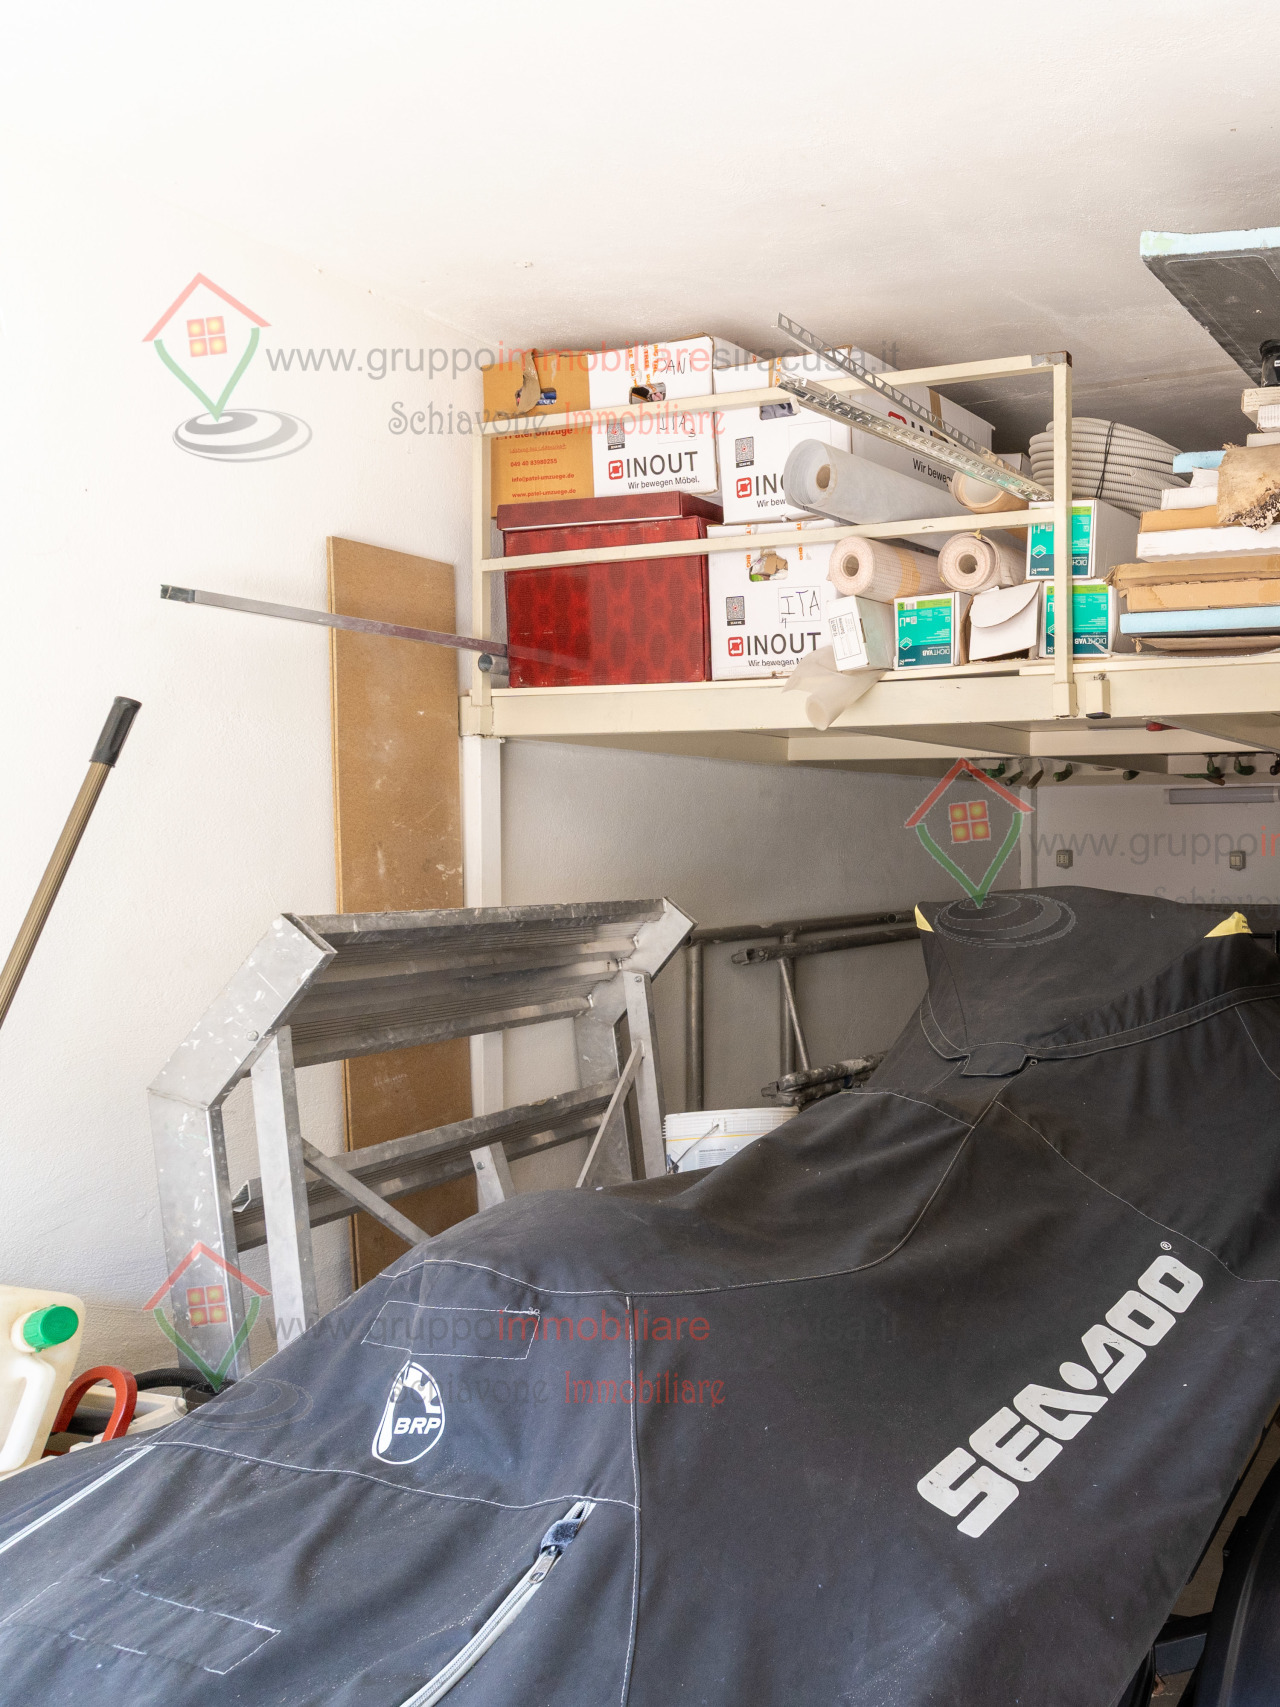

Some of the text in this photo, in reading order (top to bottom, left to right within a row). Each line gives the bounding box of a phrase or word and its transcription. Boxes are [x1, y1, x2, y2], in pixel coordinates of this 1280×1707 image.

[626, 451, 698, 478] INOUT
[913, 457, 926, 473] Wir
[628, 481, 639, 490] Wir
[640, 479, 674, 490] bewegen
[780, 589, 820, 617] ITA
[746, 632, 822, 656] INOUT
[394, 1416, 442, 1435] BRP
